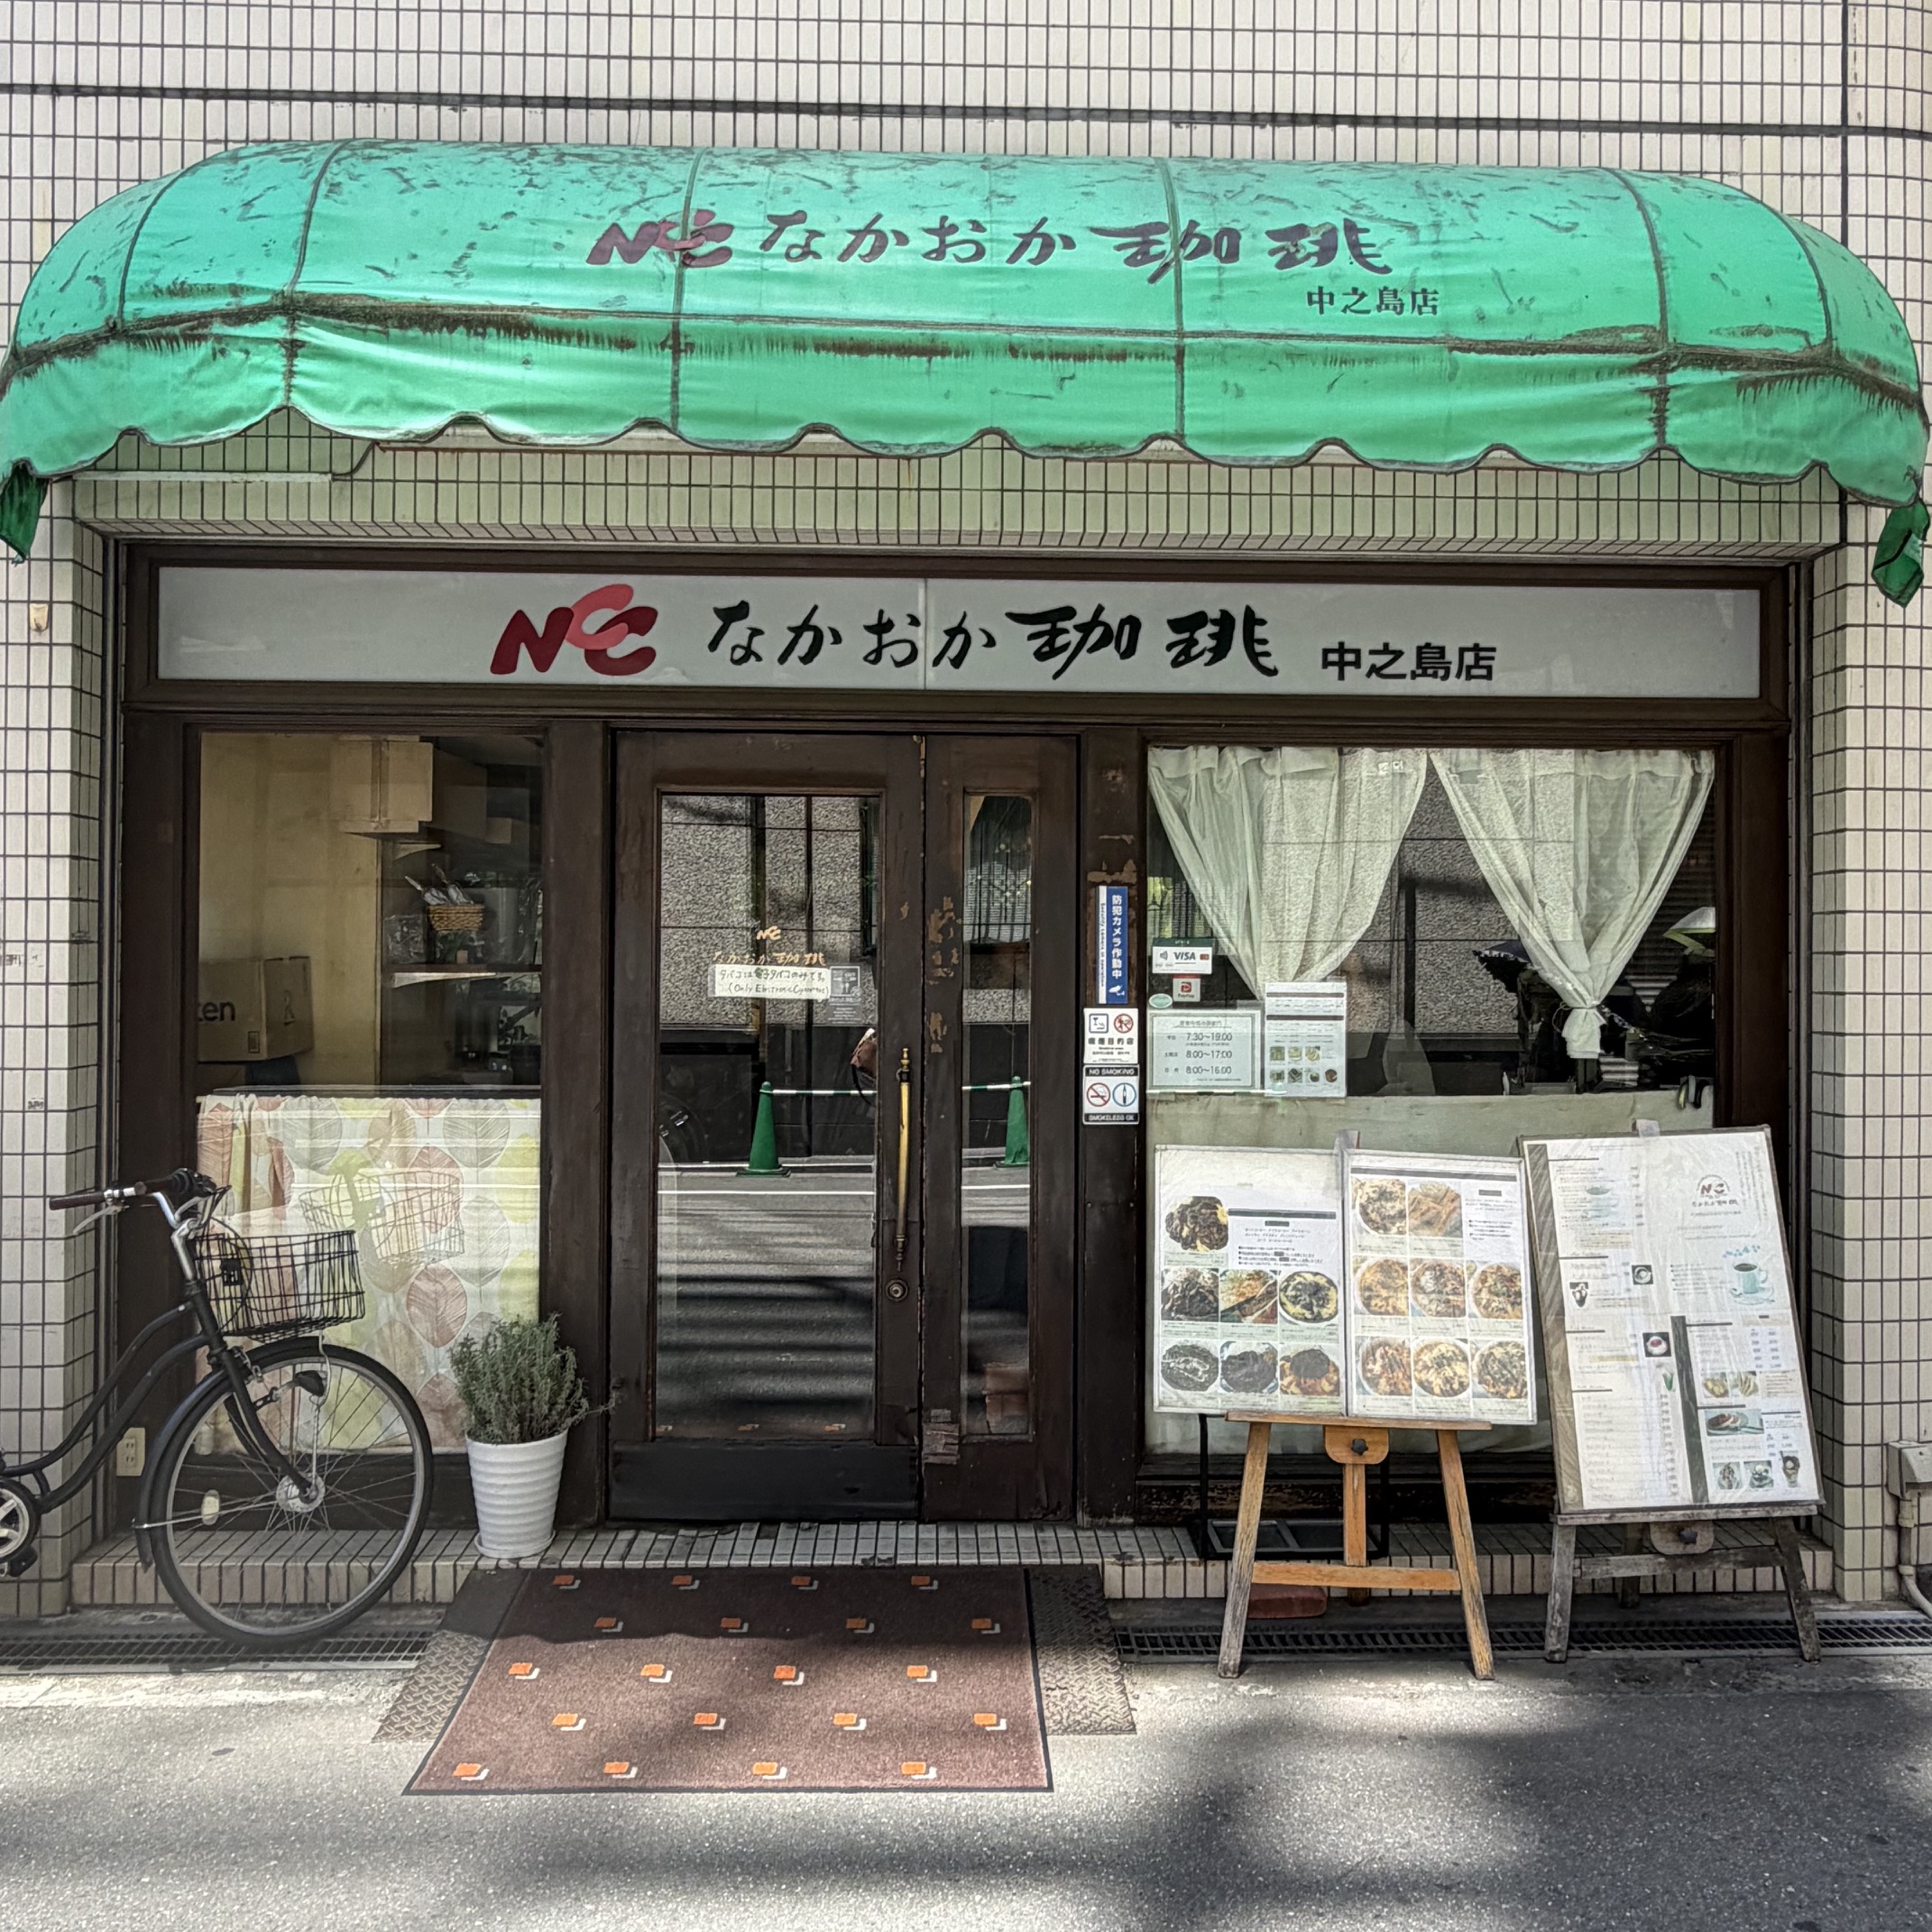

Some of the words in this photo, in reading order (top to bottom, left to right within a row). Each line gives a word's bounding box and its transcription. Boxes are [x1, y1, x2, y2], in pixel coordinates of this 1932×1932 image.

[759, 210, 1394, 284] なかおか珈琲
[1307, 285, 1440, 316] 中之島店
[707, 600, 1279, 679] なかおか珈琲
[1321, 641, 1497, 681] 中之島店
[1111, 894, 1123, 980] 防犯カメラ作動中
[1173, 952, 1196, 961] VISA
[198, 1002, 235, 1022] en
